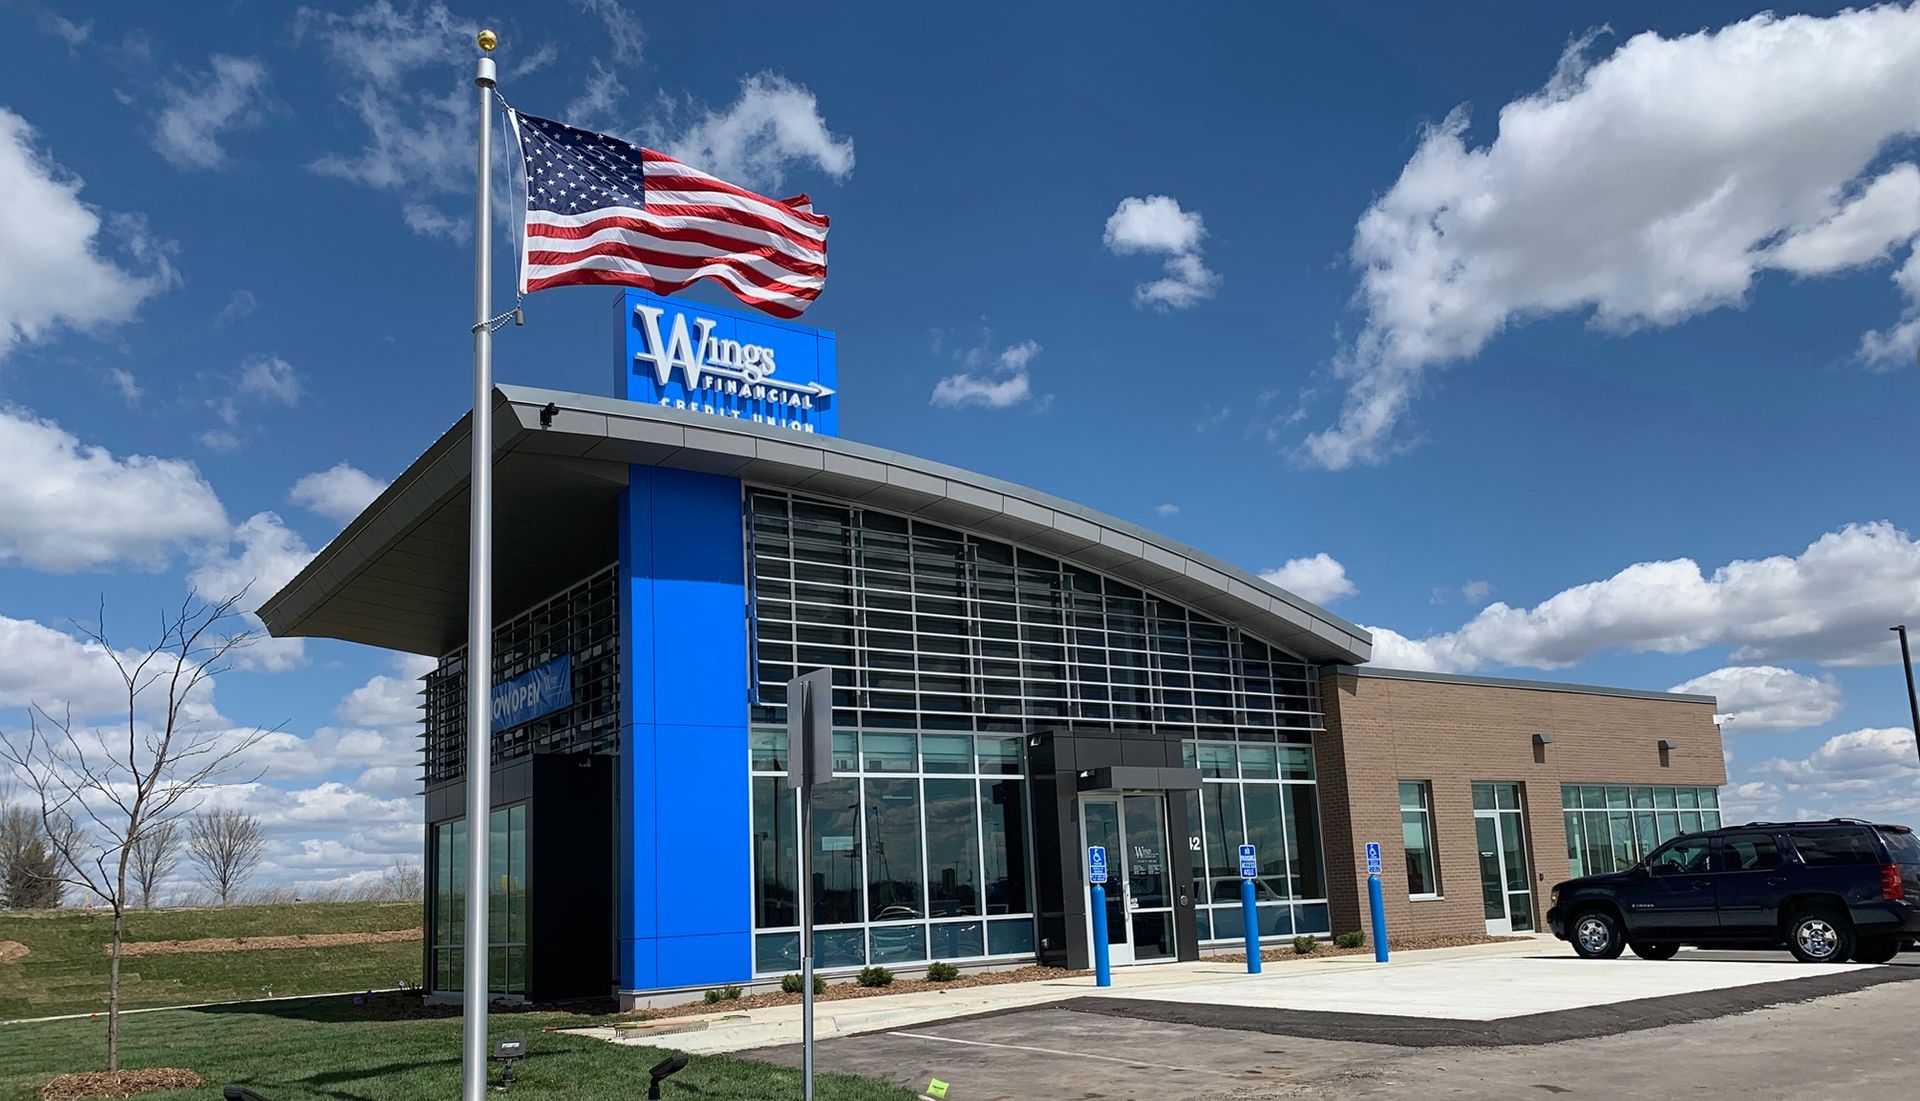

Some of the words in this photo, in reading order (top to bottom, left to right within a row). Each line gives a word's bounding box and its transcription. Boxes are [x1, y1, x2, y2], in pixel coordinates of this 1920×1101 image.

[634, 304, 776, 391] Wings
[660, 397, 742, 418] CREDIT
[702, 375, 814, 410] FINANCIAL
[491, 692, 511, 720] OW
